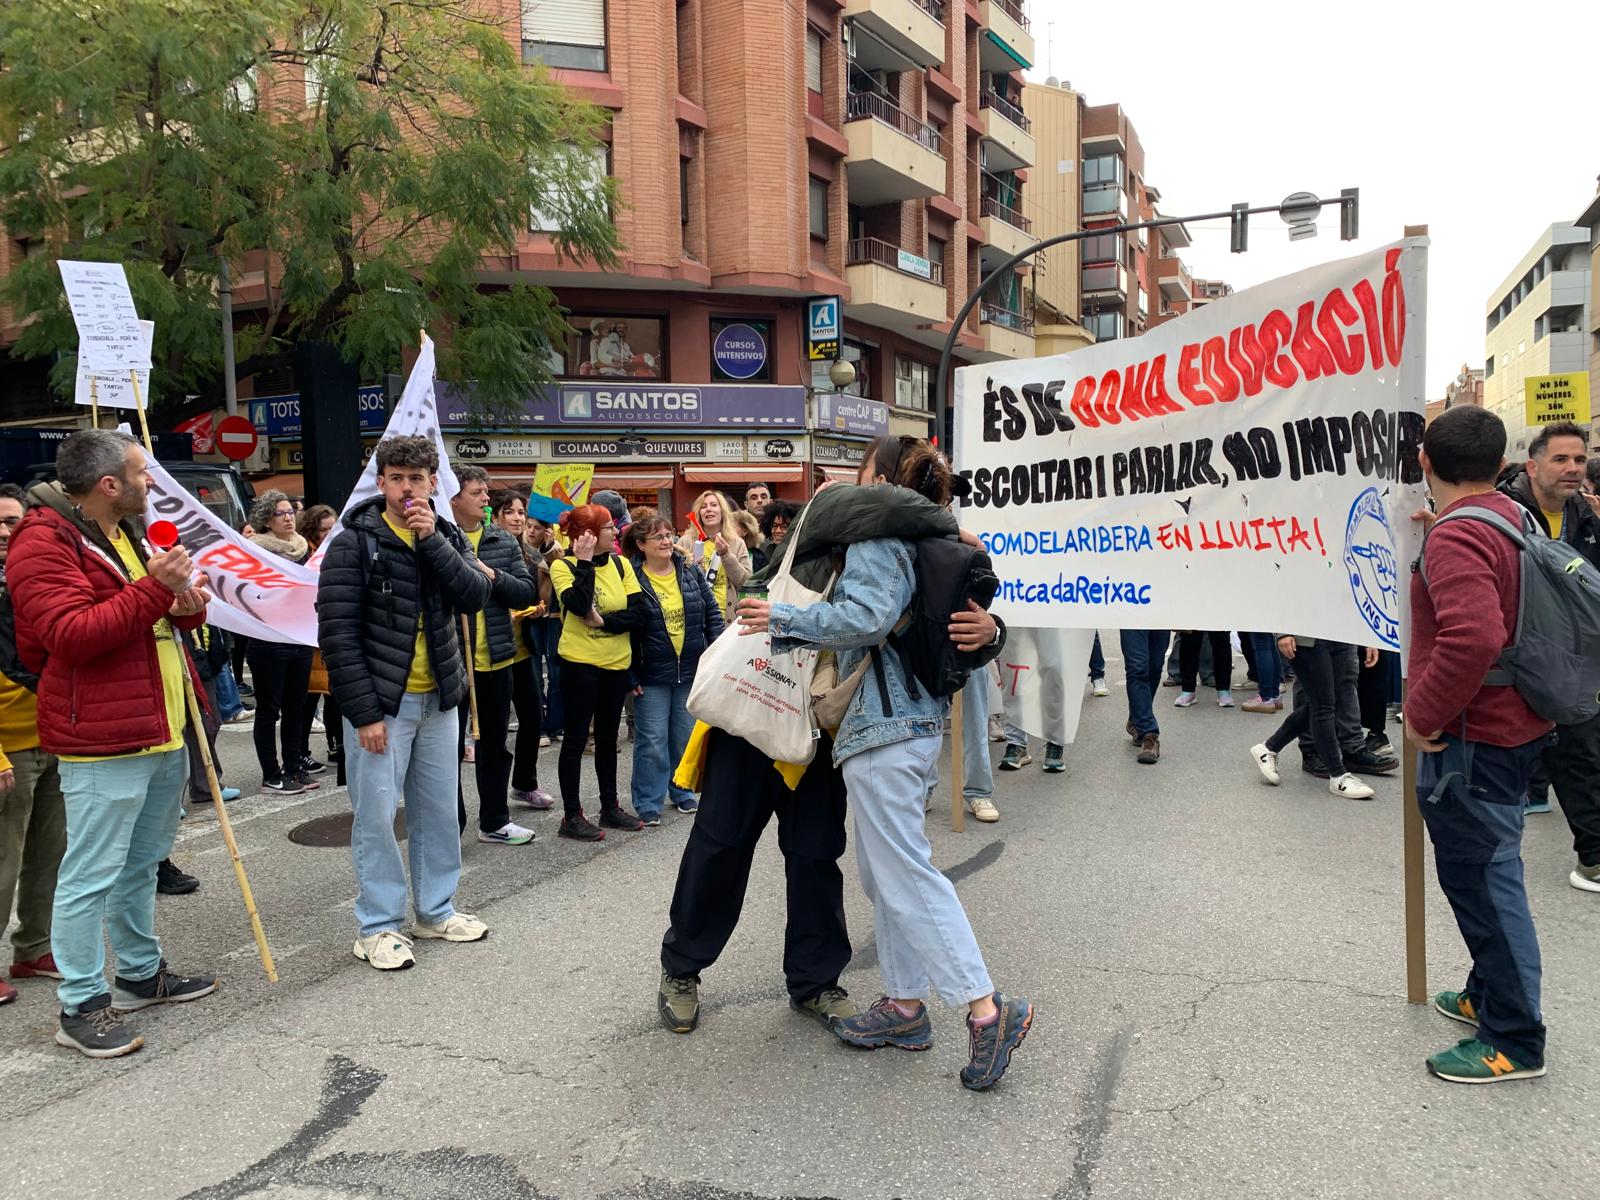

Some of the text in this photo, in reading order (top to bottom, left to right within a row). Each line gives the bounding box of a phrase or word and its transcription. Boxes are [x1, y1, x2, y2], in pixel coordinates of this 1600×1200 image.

[812, 327, 835, 335] SANTOS
[724, 340, 756, 349] CURSOS
[983, 248, 1407, 442] ÉS DE BONA EDUCACIÓ
[717, 351, 764, 360] INTENSIVOS
[1540, 378, 1569, 389] NO SÓN
[596, 391, 698, 410] SANTOS
[1548, 400, 1563, 410] SÓN
[270, 401, 300, 418] TOTS
[598, 412, 697, 421] AUTOESCOLES
[1537, 413, 1575, 422] PERSONES
[458, 444, 487, 454] Fresh
[558, 443, 702, 453] COLMADO QUEVIURES
[766, 445, 792, 454] Fresh
[957, 456, 1093, 508] ESCOLTAR
[1095, 455, 1107, 498] I
[1222, 427, 1281, 481] NO
[1156, 523, 1193, 551] EN
[1199, 515, 1326, 556] LLUITA!
[723, 673, 737, 681] Som
[736, 686, 749, 695] som
